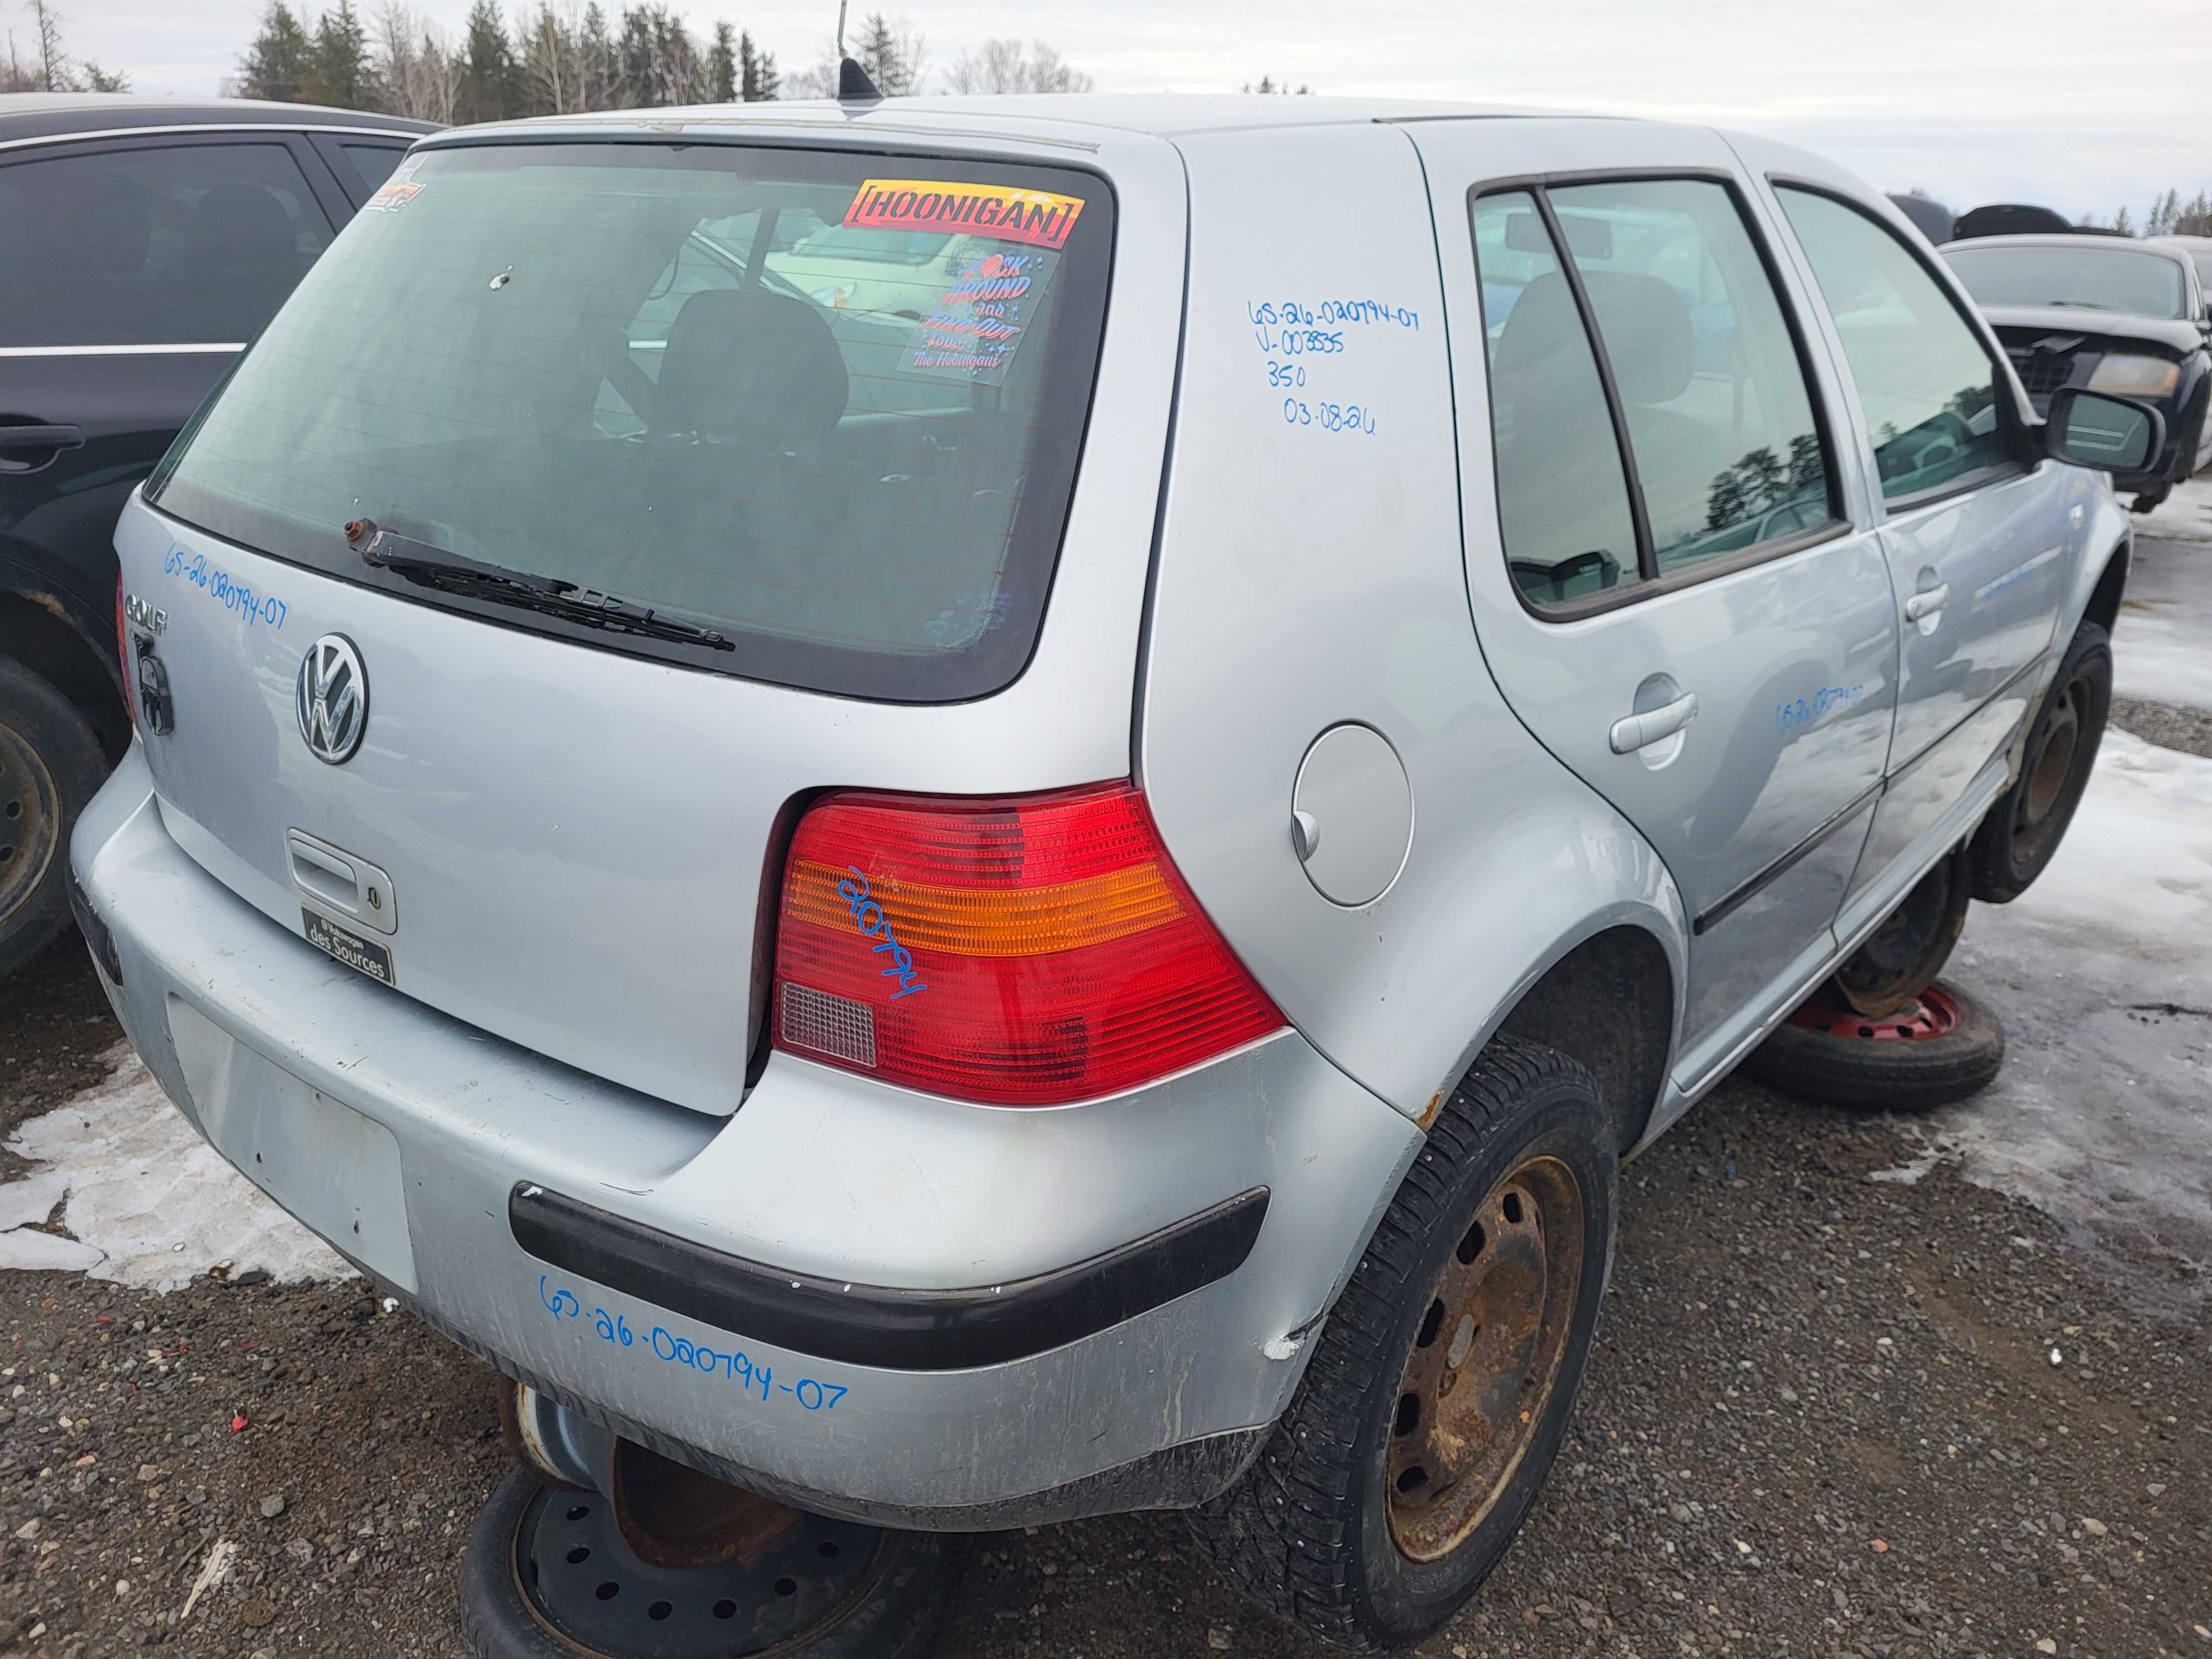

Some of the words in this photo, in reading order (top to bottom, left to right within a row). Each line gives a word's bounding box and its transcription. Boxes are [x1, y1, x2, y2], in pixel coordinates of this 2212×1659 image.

[963, 253, 1029, 279] FCK
[940, 276, 1032, 305] AROUND
[972, 317, 1022, 341] OUT
[913, 351, 935, 367] The
[1267, 361, 1306, 387] 350
[125, 593, 168, 637] GOLF
[838, 865, 927, 1000] 20794
[310, 924, 331, 950] des
[332, 936, 385, 978] Sources
